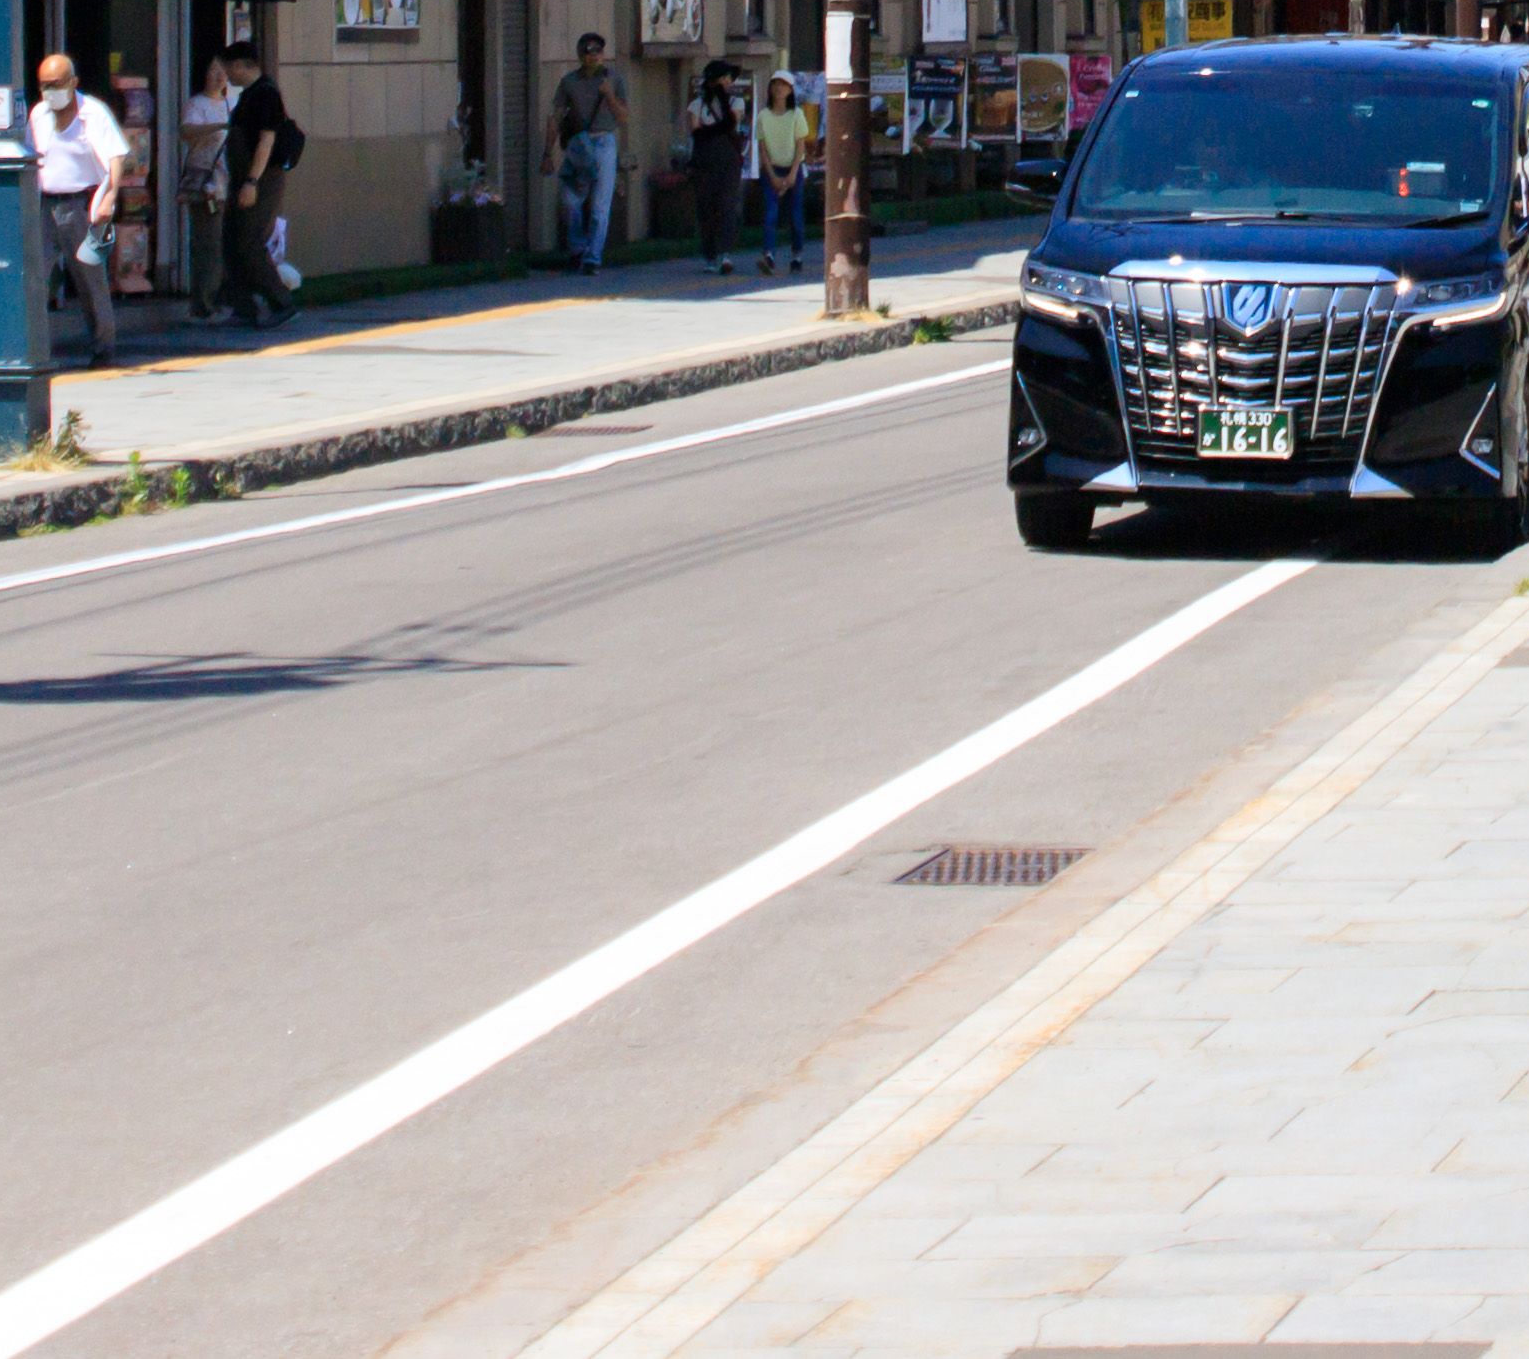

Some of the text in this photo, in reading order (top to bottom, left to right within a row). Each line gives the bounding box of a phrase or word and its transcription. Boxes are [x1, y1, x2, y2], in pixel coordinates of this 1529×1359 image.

[1220, 411, 1271, 426] 札幌 330
[1221, 426, 1287, 452] 16-16
